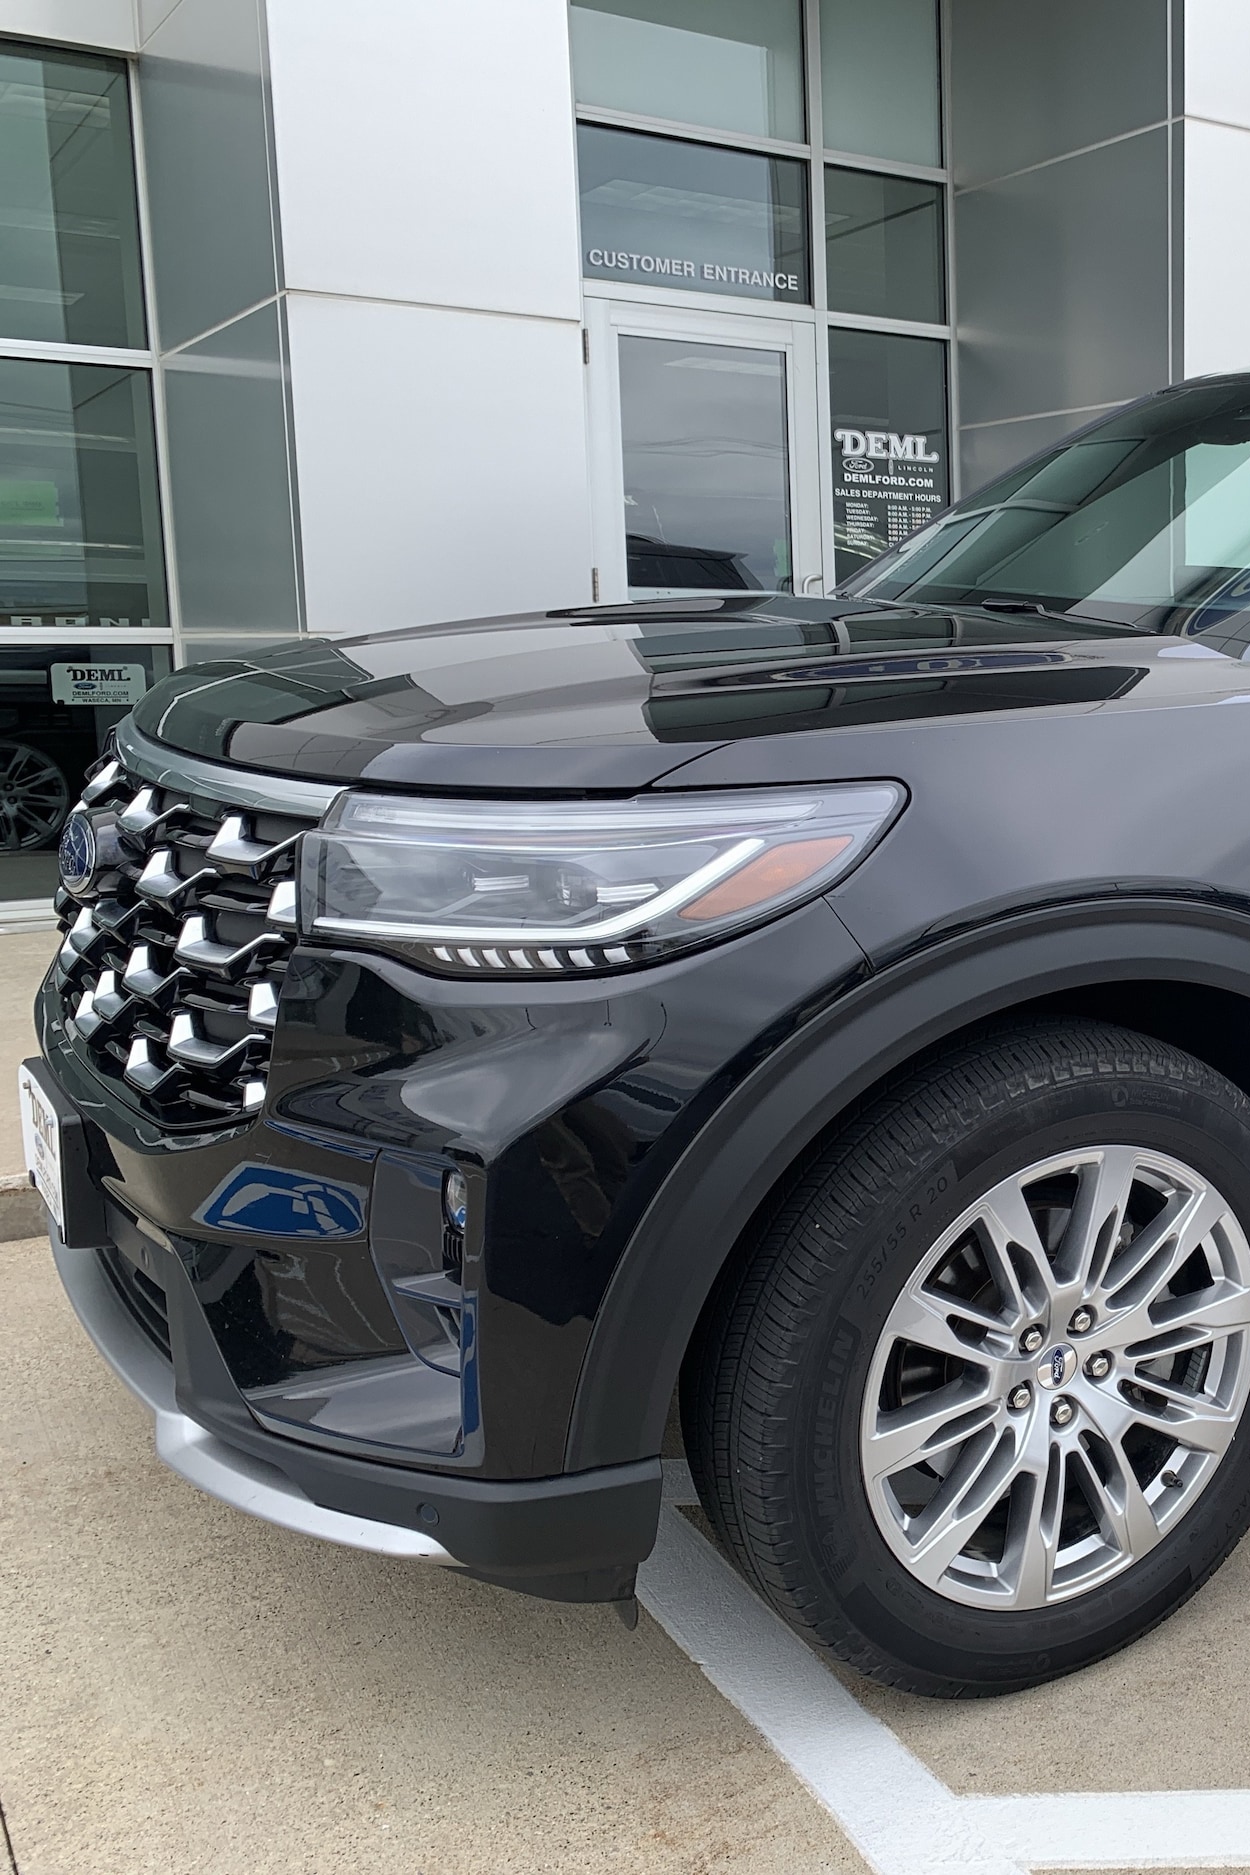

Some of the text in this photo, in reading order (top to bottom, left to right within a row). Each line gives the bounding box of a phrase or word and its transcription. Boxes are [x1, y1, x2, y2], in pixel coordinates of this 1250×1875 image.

[589, 249, 799, 290] CUSTOMER ENTRANCE
[834, 429, 939, 463] DEML
[843, 473, 934, 488] DEMLFORD.COM
[898, 465, 934, 473] LINCOLN
[835, 488, 941, 503] SALES DEPARTMENT HOURS
[66, 668, 131, 682] DEML
[856, 1176, 948, 1300] 255/55 R 20
[814, 1333, 850, 1531] MICHELIN
